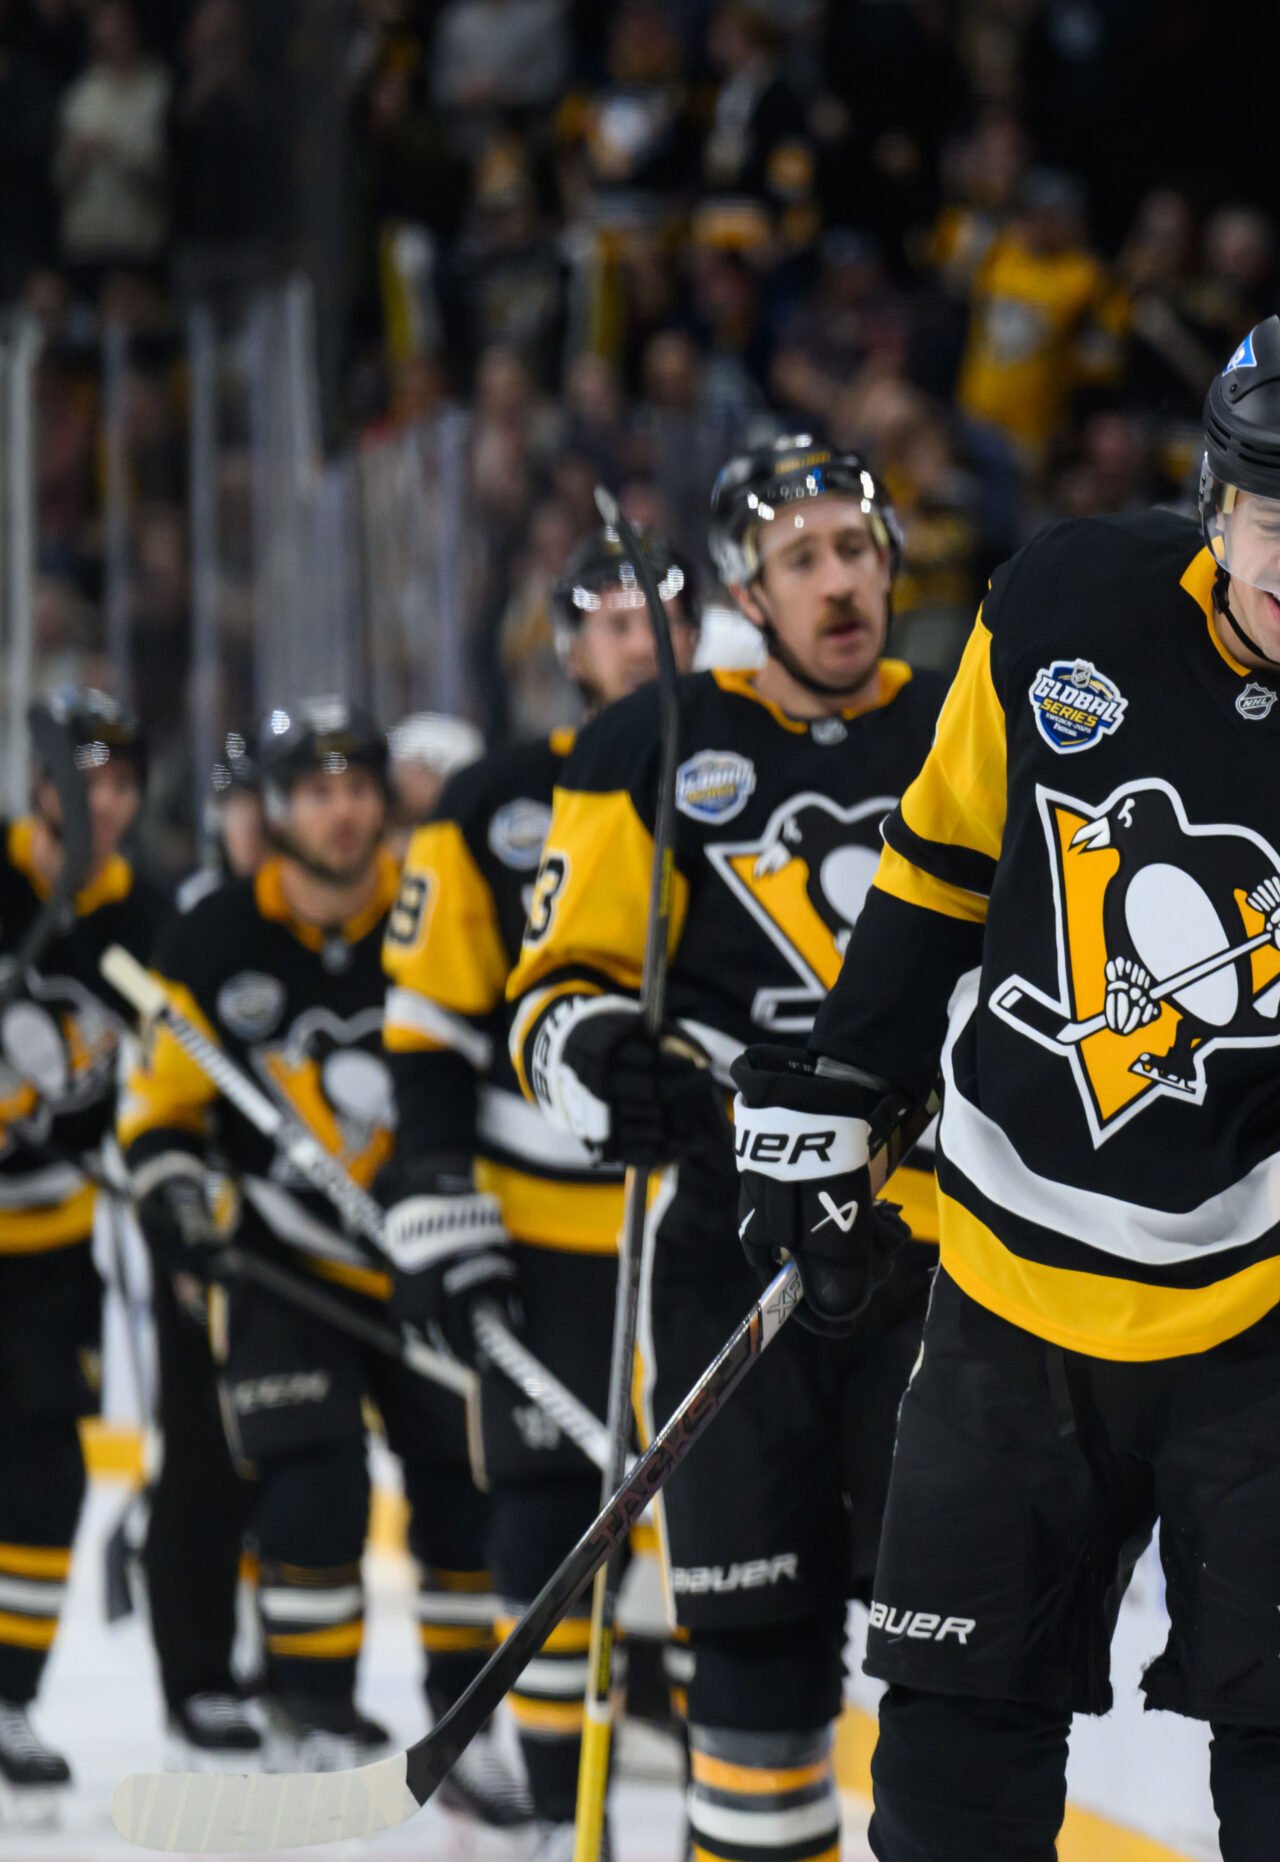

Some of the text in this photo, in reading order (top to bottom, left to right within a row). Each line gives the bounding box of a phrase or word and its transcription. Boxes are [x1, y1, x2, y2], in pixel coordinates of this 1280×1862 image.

[1034, 675, 1119, 723] GLOBAL
[1040, 698, 1099, 727] SERIES
[1242, 697, 1267, 708] NHL
